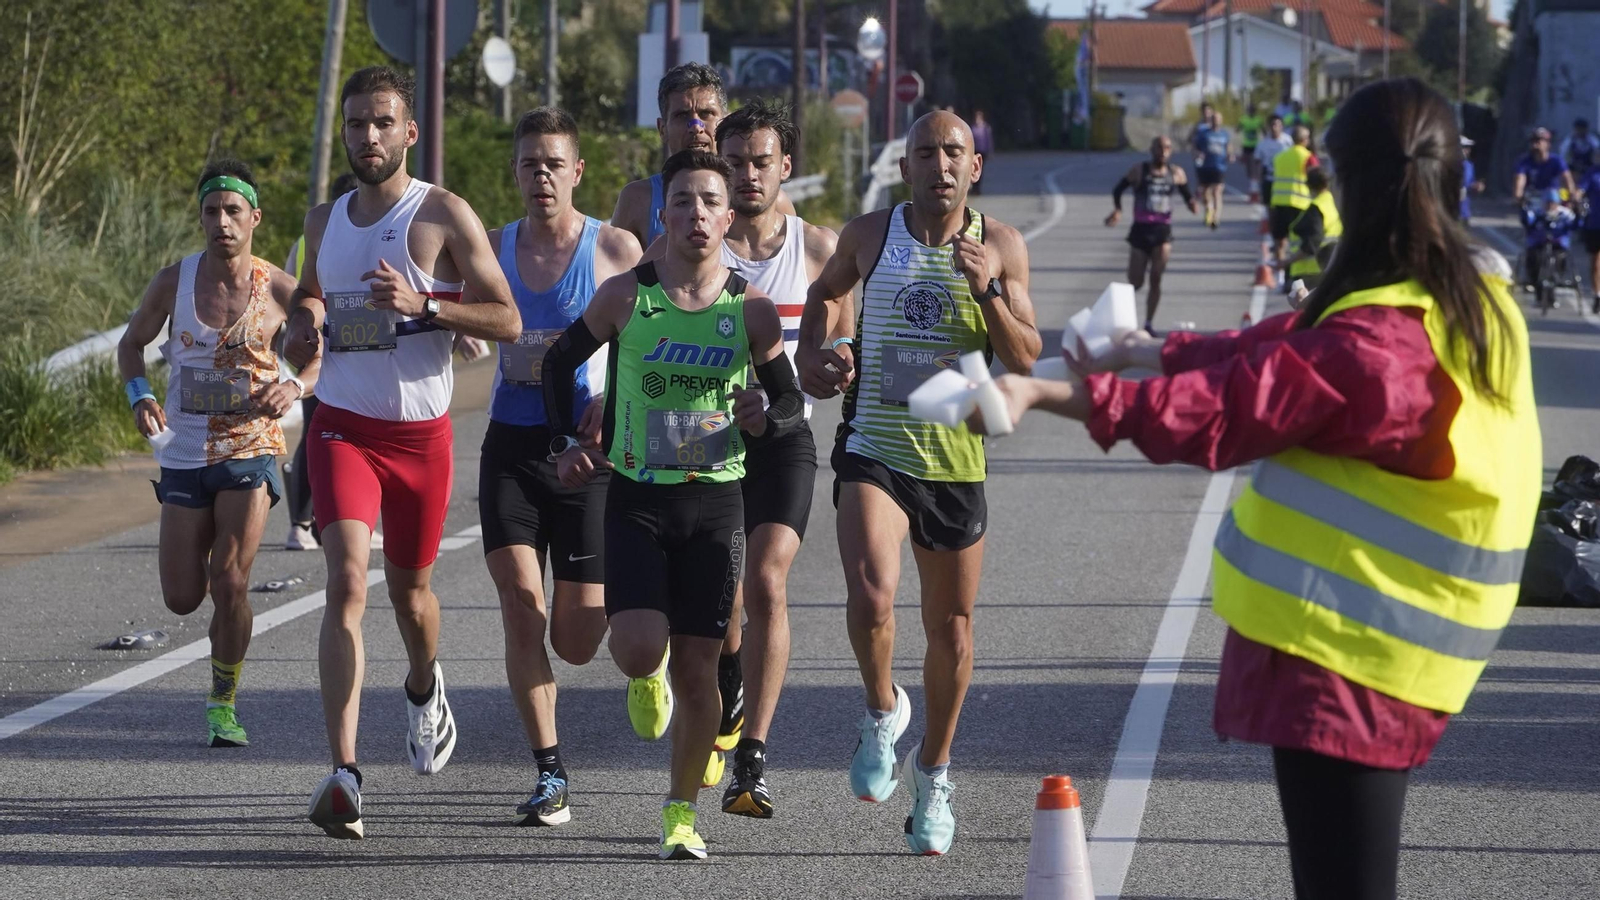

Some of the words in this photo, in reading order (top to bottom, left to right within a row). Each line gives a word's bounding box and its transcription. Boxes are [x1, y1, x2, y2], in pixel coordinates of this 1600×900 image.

[333, 297, 345, 309] VIG
[349, 296, 365, 308] BAY
[341, 323, 379, 345] 602
[528, 334, 544, 345] BAY
[195, 340, 207, 348] NN
[897, 351, 912, 364] VIG
[916, 353, 935, 365] BAY
[193, 371, 206, 381] VIG
[209, 373, 224, 382] BAY
[669, 373, 731, 393] PREVENT
[193, 393, 241, 411] 5118
[663, 414, 679, 427] VIG
[682, 415, 701, 427] BAY
[676, 443, 706, 464] 68
